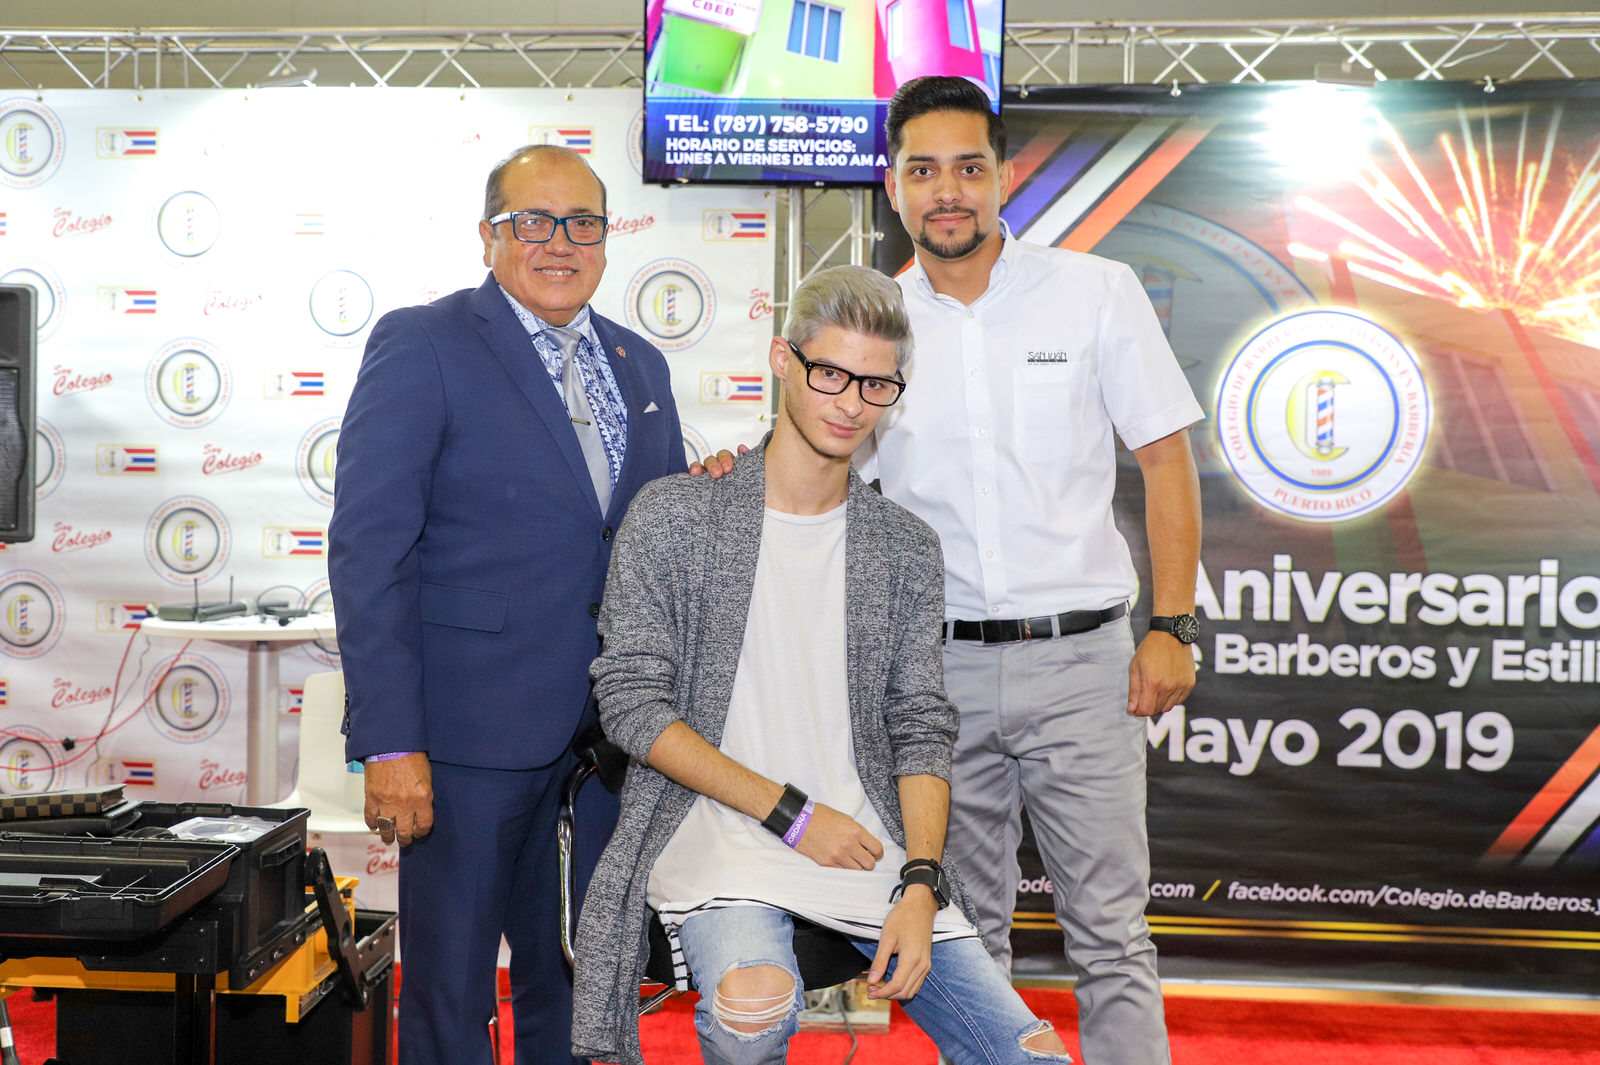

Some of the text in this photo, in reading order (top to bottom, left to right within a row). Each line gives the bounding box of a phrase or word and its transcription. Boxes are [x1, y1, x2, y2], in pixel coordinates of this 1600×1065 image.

[665, 114, 709, 132] TEL:
[713, 114, 766, 135] (787)
[769, 116, 869, 134] 758-5790
[665, 138, 856, 153] HORARIO DE SERVICIOS:
[665, 152, 888, 167] LUNES A VIERNES DE 8:00 AM A
[52, 213, 113, 239] Colegio
[608, 214, 655, 235] olegio
[52, 371, 113, 396] Colegio
[1226, 394, 1248, 461] COLEGIO
[202, 450, 262, 476] Colegio
[1273, 487, 1372, 511] PUERTO RICO
[52, 528, 112, 553] Colegio
[1195, 554, 1600, 629] Aniversario
[1215, 633, 1437, 679] Barberos
[1446, 646, 1481, 688] y
[51, 685, 112, 709] Colegio
[1147, 704, 1514, 776] Mayo 2019
[198, 768, 246, 790] Coleg
